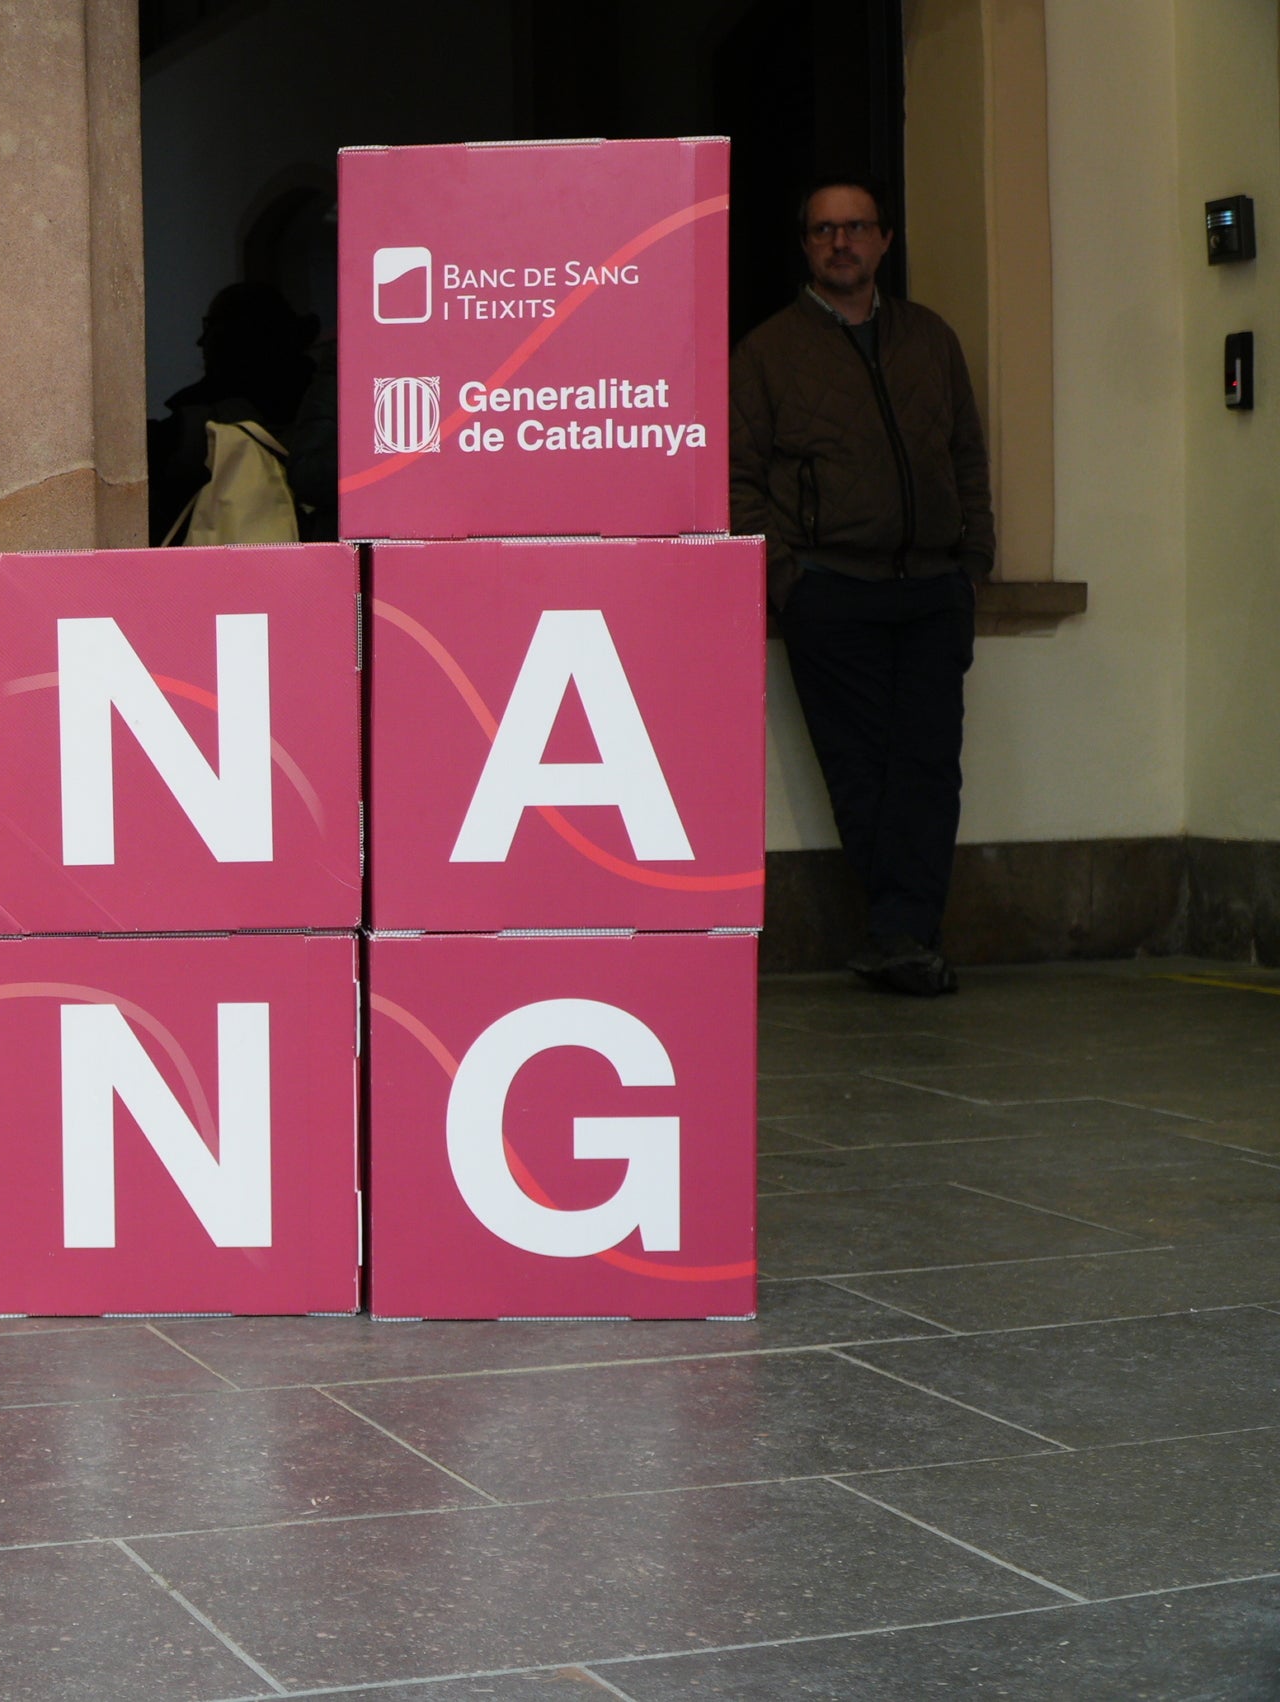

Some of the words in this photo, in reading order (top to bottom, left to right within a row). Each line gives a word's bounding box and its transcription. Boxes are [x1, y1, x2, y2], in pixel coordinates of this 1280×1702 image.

[443, 264, 516, 289] BANC
[524, 267, 557, 288] DE
[564, 260, 640, 287] SANG
[457, 295, 557, 320] TEIXITS
[458, 378, 669, 413] Generalitat
[458, 421, 505, 453] de
[516, 418, 707, 457] Catalunya
